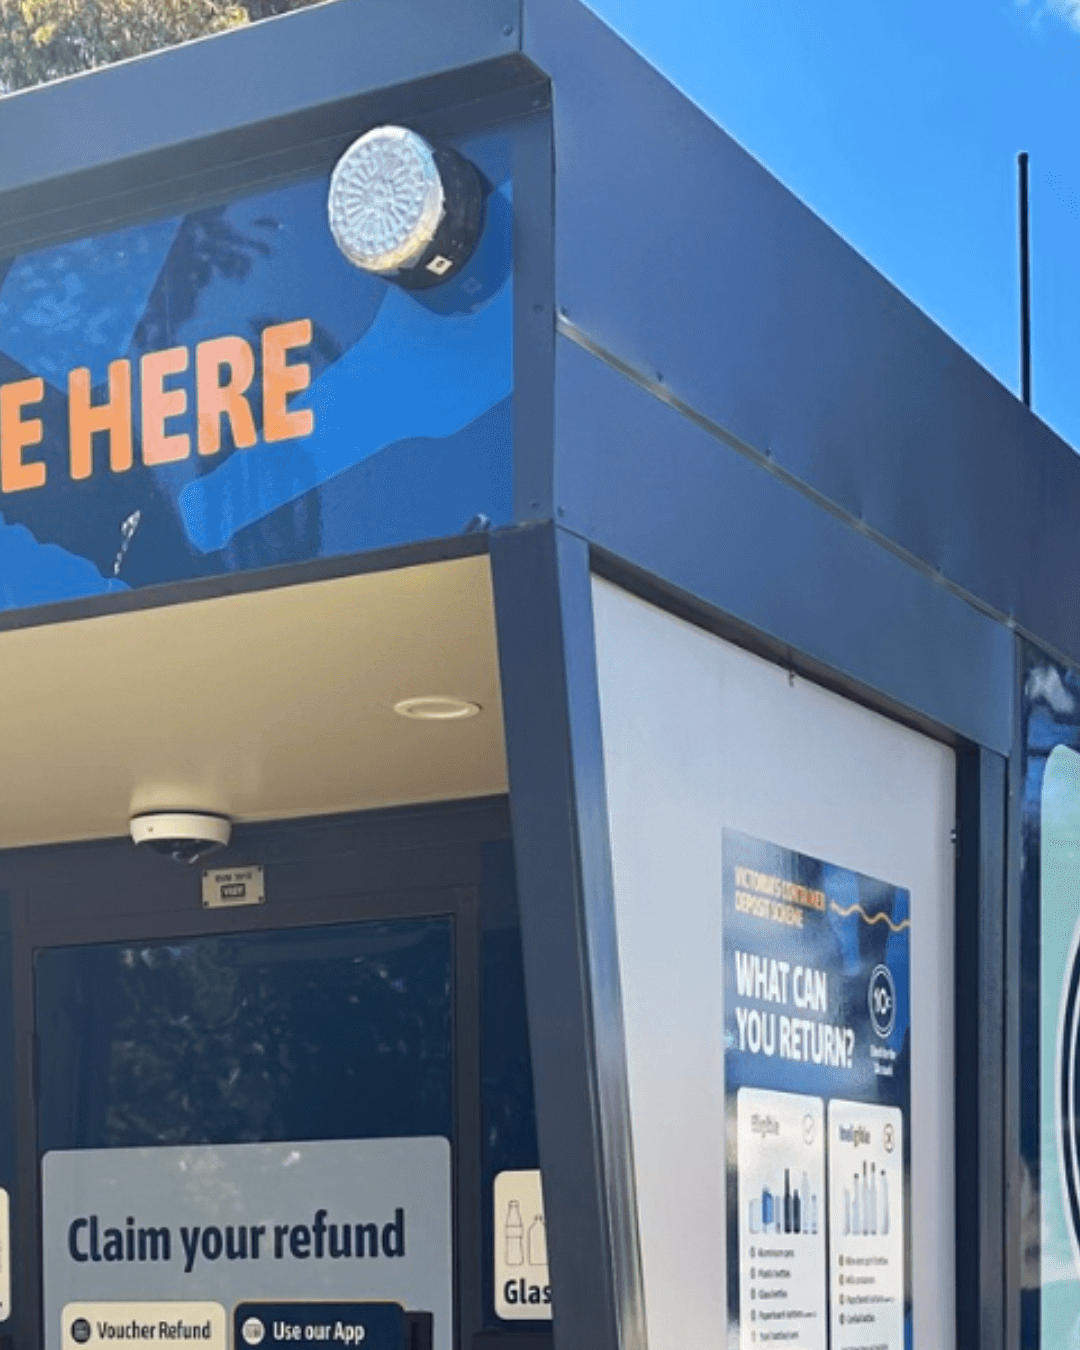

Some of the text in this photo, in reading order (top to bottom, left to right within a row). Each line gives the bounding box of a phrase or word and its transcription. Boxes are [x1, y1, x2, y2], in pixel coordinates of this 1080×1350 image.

[68, 318, 314, 481] HERE
[735, 950, 828, 1013] WHAT CAN
[735, 1007, 775, 1056] YOU
[780, 1015, 855, 1069] RETURN?
[68, 1208, 406, 1273] Claim your refund
[97, 1319, 211, 1339] Voucher Refund
[273, 1321, 364, 1345] Use our App
